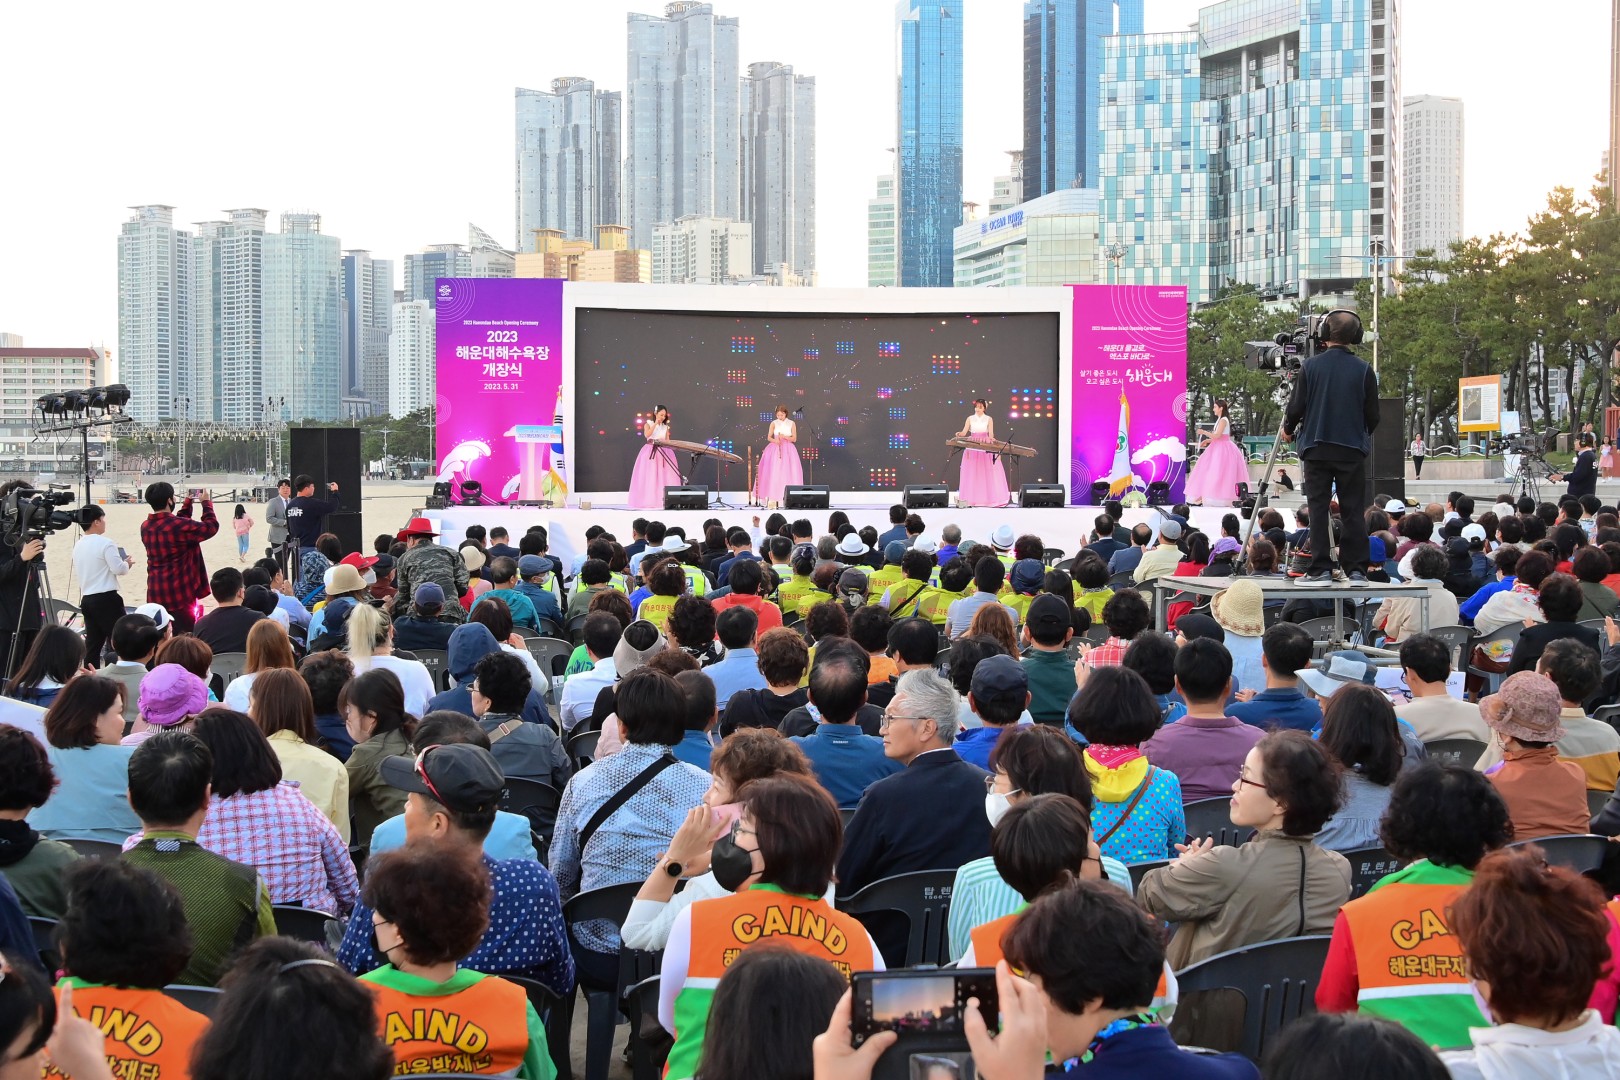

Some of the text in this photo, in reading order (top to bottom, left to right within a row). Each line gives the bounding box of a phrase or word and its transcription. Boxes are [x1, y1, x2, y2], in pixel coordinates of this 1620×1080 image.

[989, 216, 1007, 231] OCEAN
[1007, 210, 1024, 225] TOWER
[486, 330, 519, 343] 2023
[455, 345, 550, 361] 해운대해수욕장
[482, 362, 523, 378] 개장식
[1106, 369, 1118, 377] 도시
[287, 508, 304, 518] STAFF
[732, 905, 848, 956] CAIND
[1388, 954, 1468, 978] 해운대구자
[385, 1008, 489, 1054] AIND
